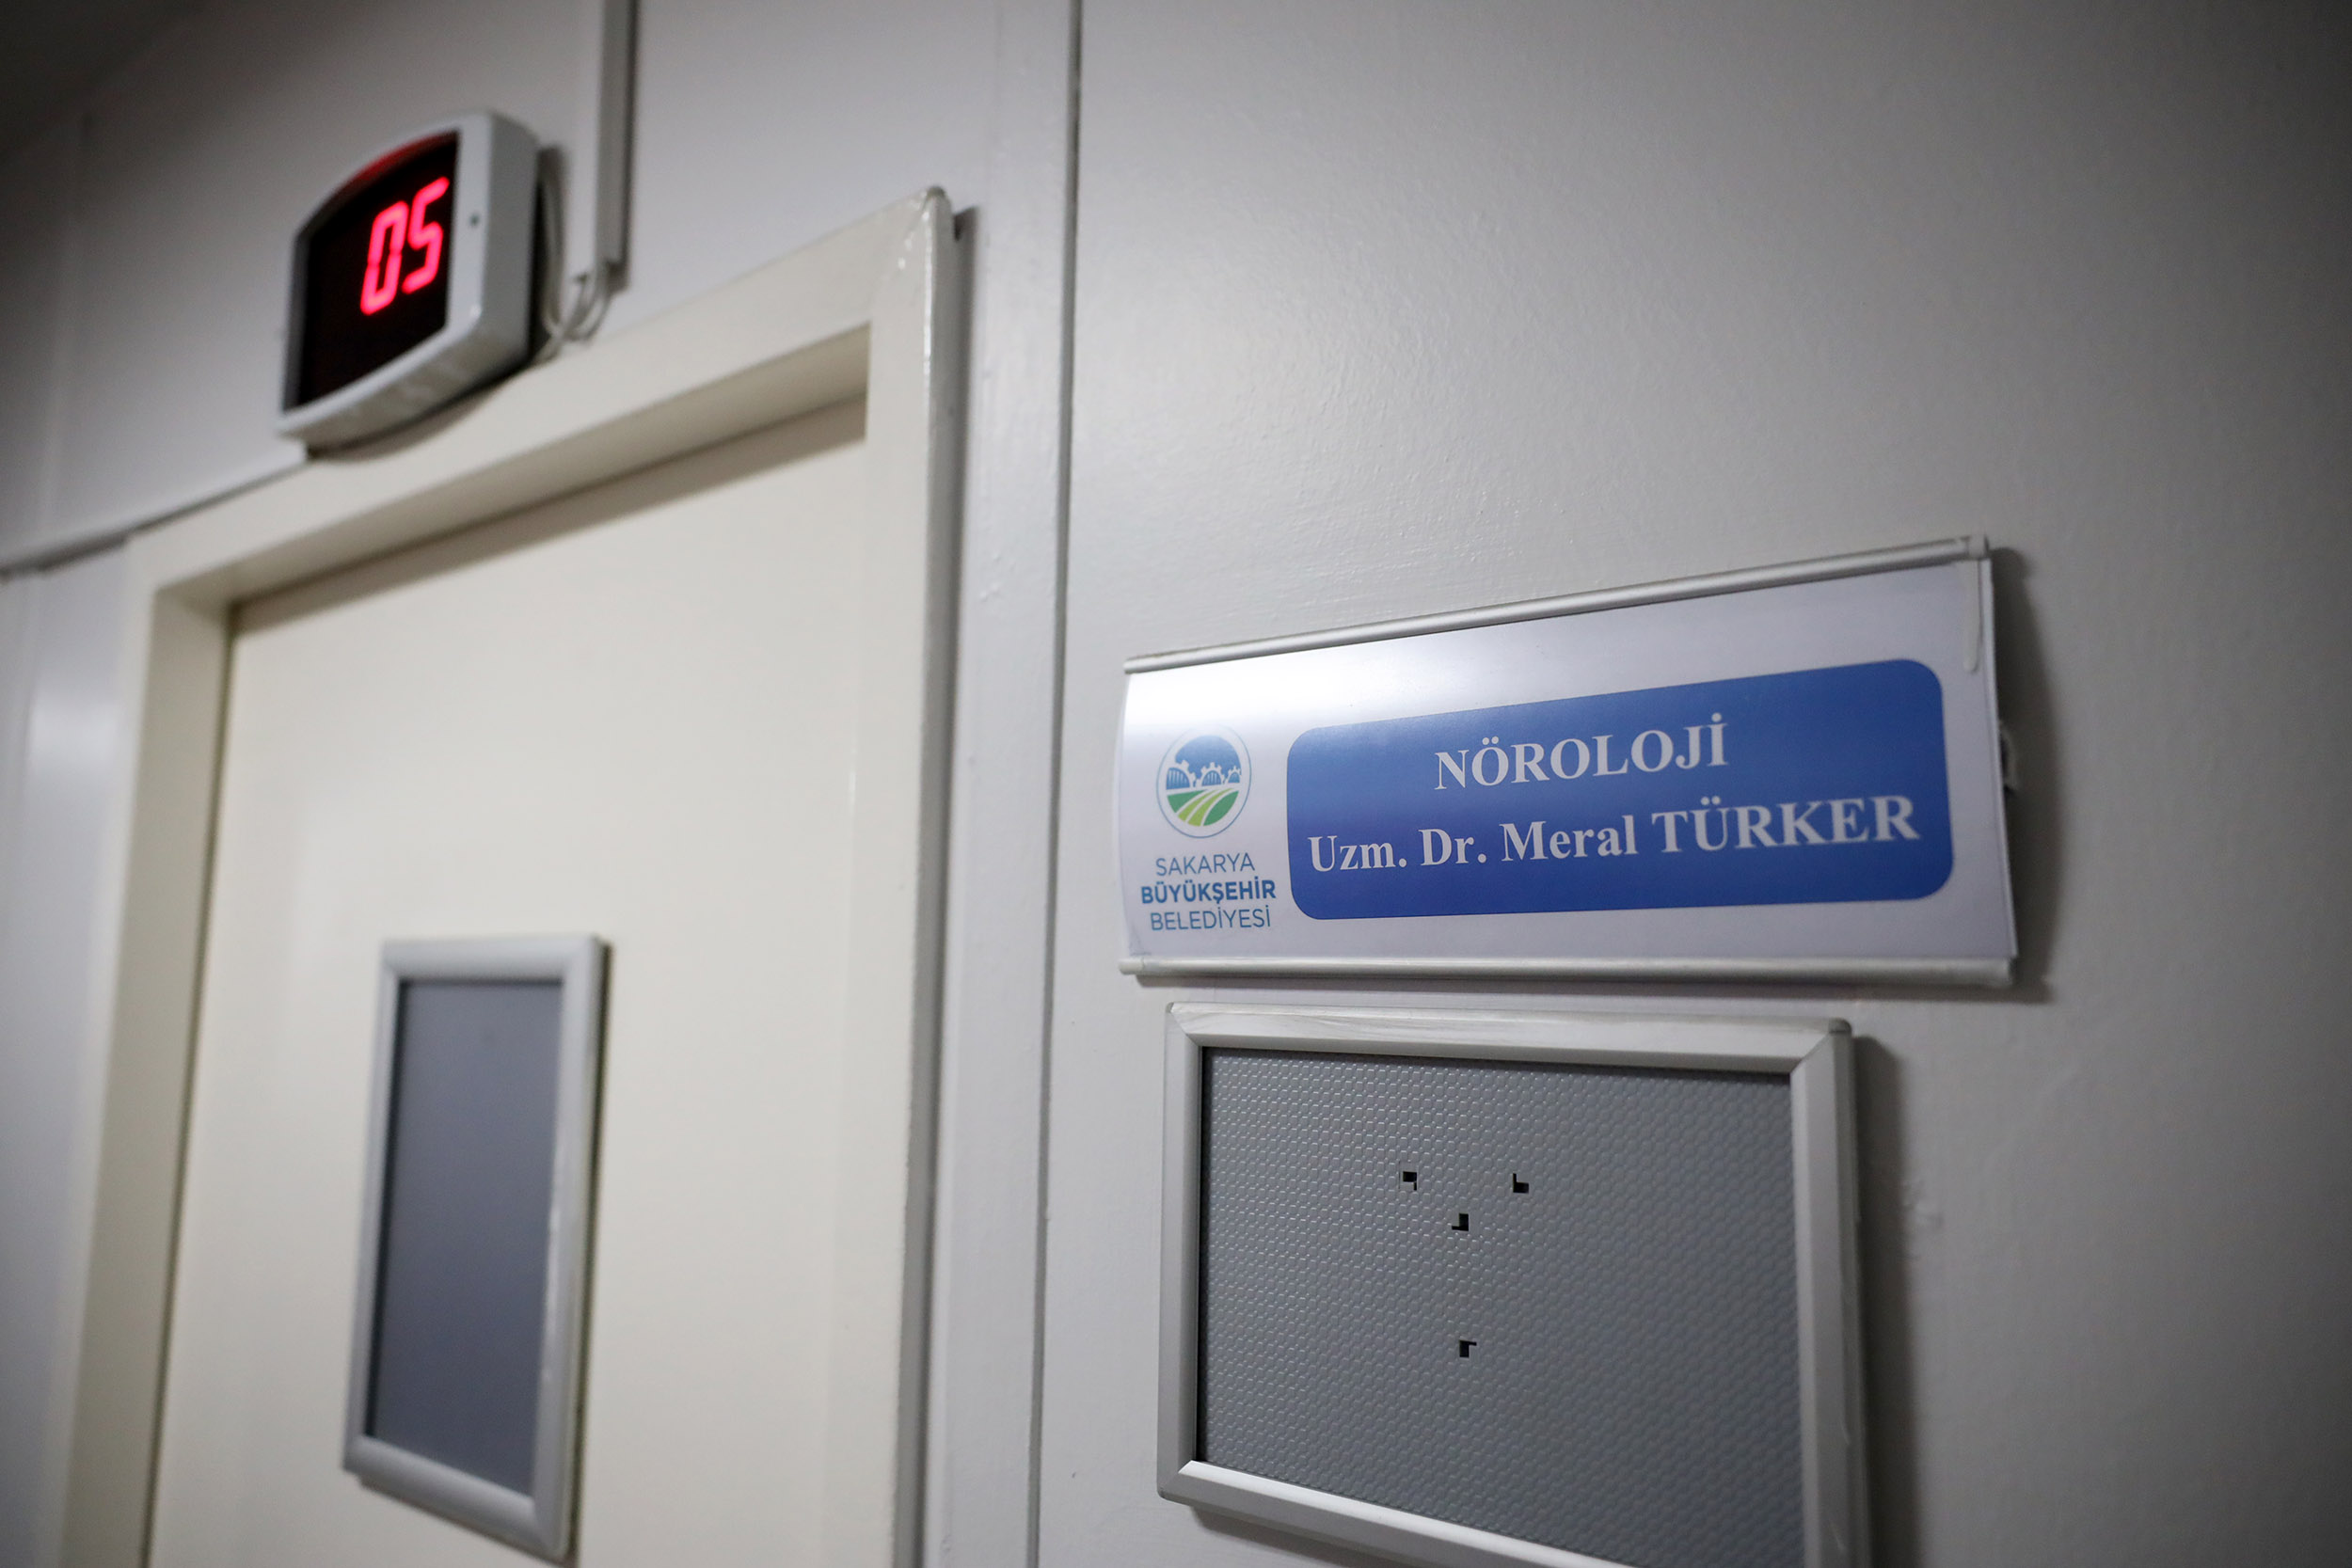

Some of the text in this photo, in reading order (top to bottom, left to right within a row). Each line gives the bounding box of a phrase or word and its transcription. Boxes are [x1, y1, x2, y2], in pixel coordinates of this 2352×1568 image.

[359, 177, 450, 316] 05
[1434, 712, 1728, 791] NÖROLOJİ
[1308, 795, 1921, 873] Uzm. Dr. Meral TÜRKER
[1141, 876, 1277, 905] BÜYÜKŞEHİR
[1155, 852, 1256, 877] SAKARYA
[1150, 904, 1271, 931] BELEDİYESİ
